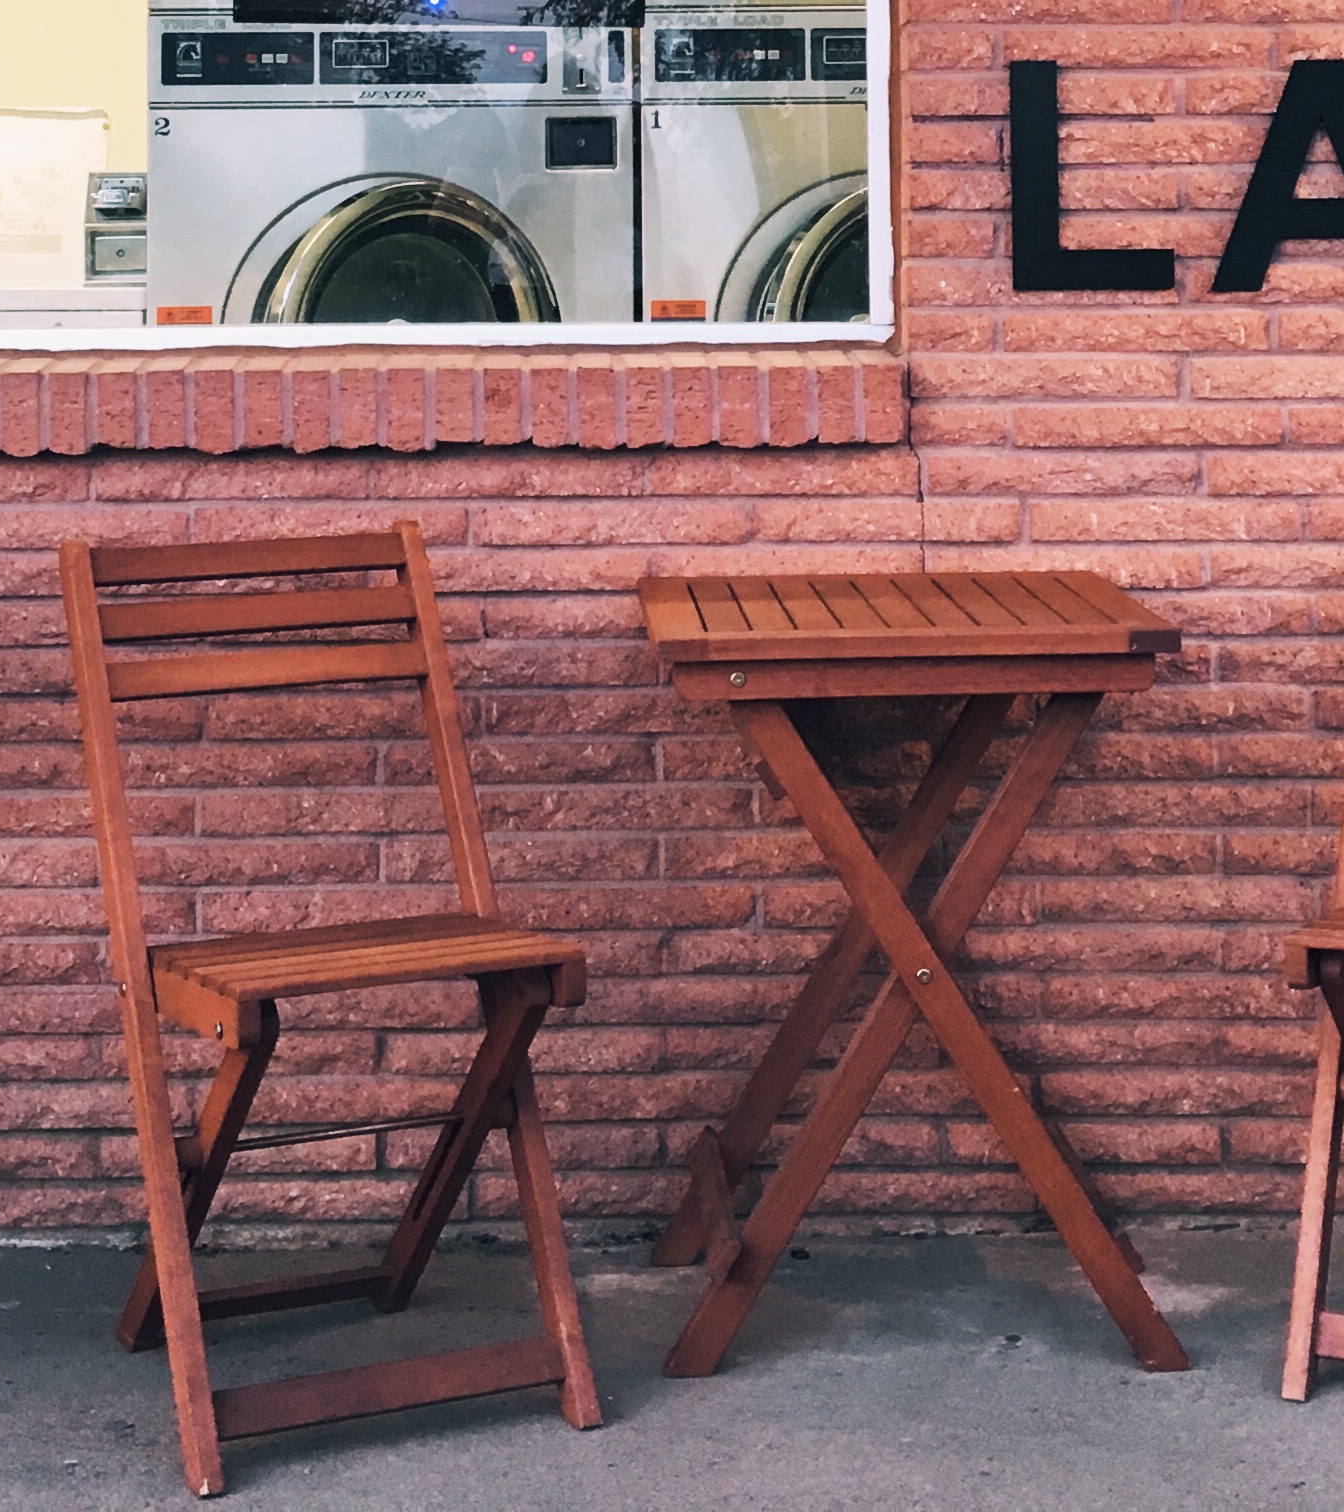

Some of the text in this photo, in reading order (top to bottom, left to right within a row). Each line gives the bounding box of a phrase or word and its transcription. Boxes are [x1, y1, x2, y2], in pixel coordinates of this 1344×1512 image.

[160, 18, 227, 29] TRIPLE
[733, 14, 785, 27] LOAD
[358, 90, 426, 99] DEXTER
[650, 110, 662, 129] 1
[154, 117, 171, 136] 2
